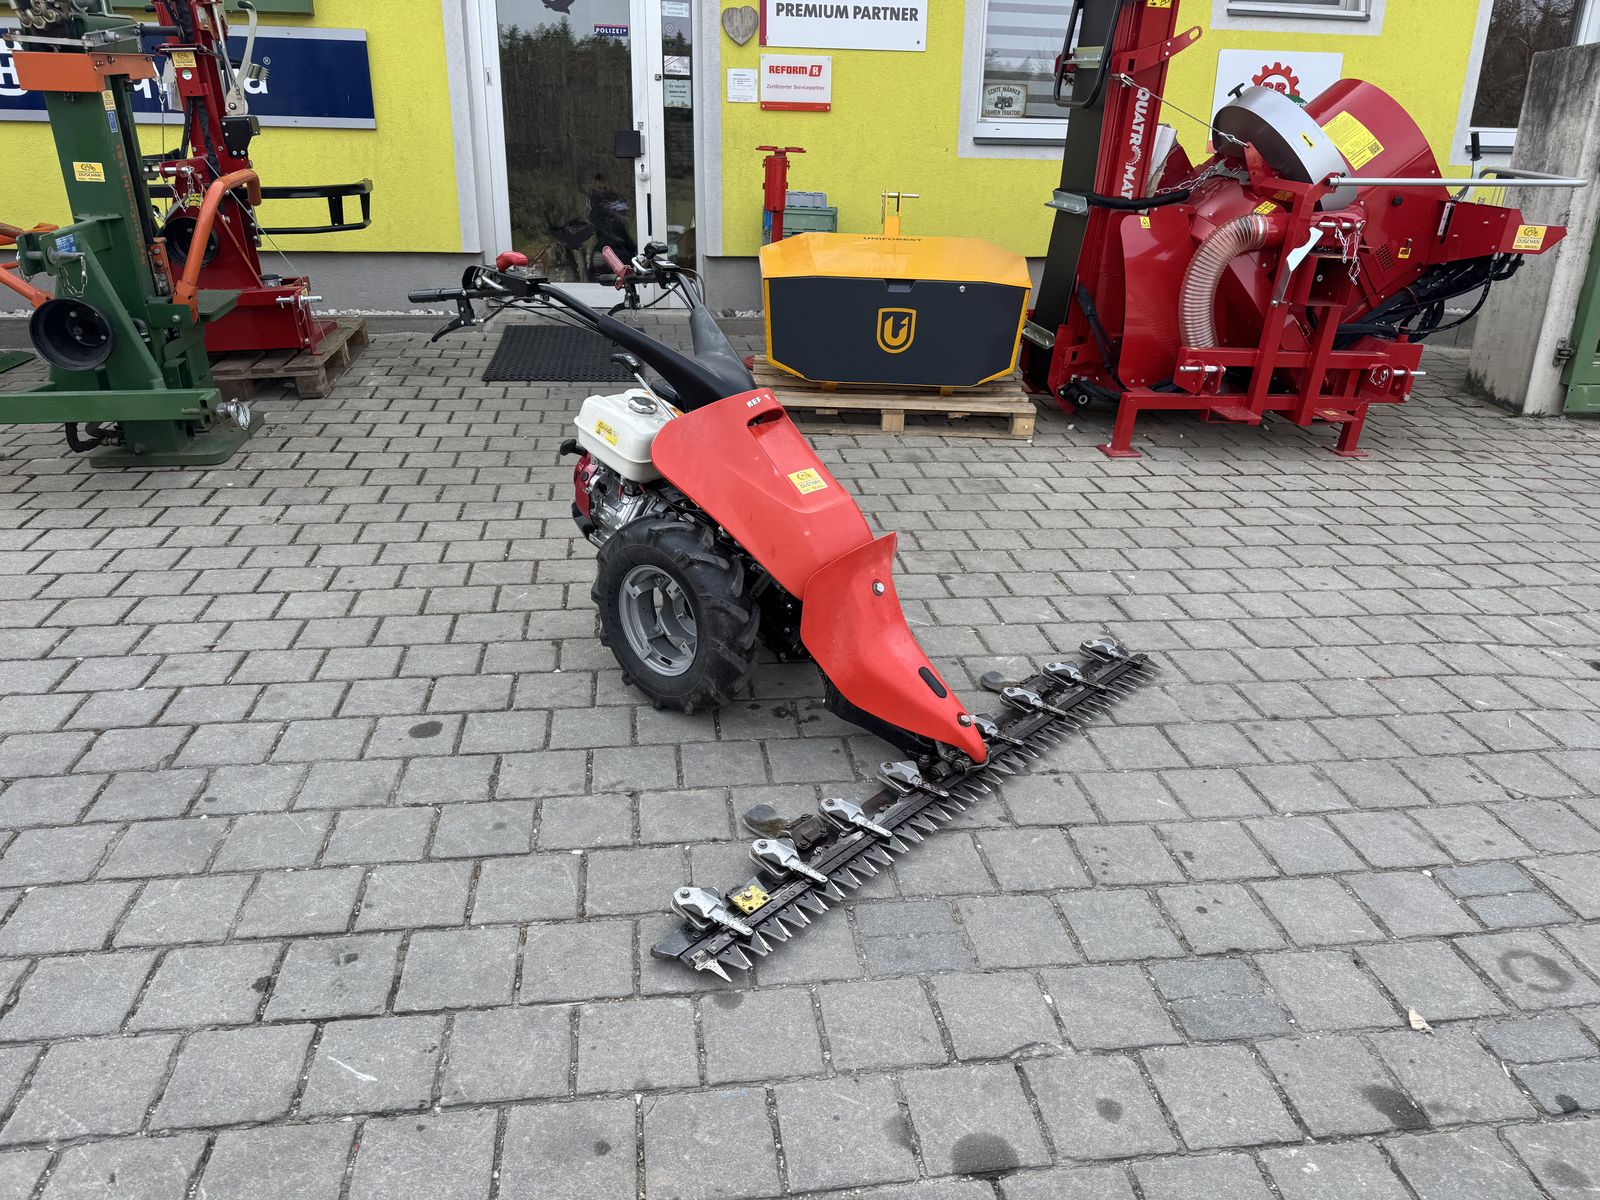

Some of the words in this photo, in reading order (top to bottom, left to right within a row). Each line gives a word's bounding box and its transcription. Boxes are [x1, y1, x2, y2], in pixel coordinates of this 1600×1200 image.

[776, 3, 849, 19] PREMIUM
[853, 6, 919, 21] PARTNER
[768, 65, 808, 75] REFORM
[987, 86, 1002, 96] ECHTE
